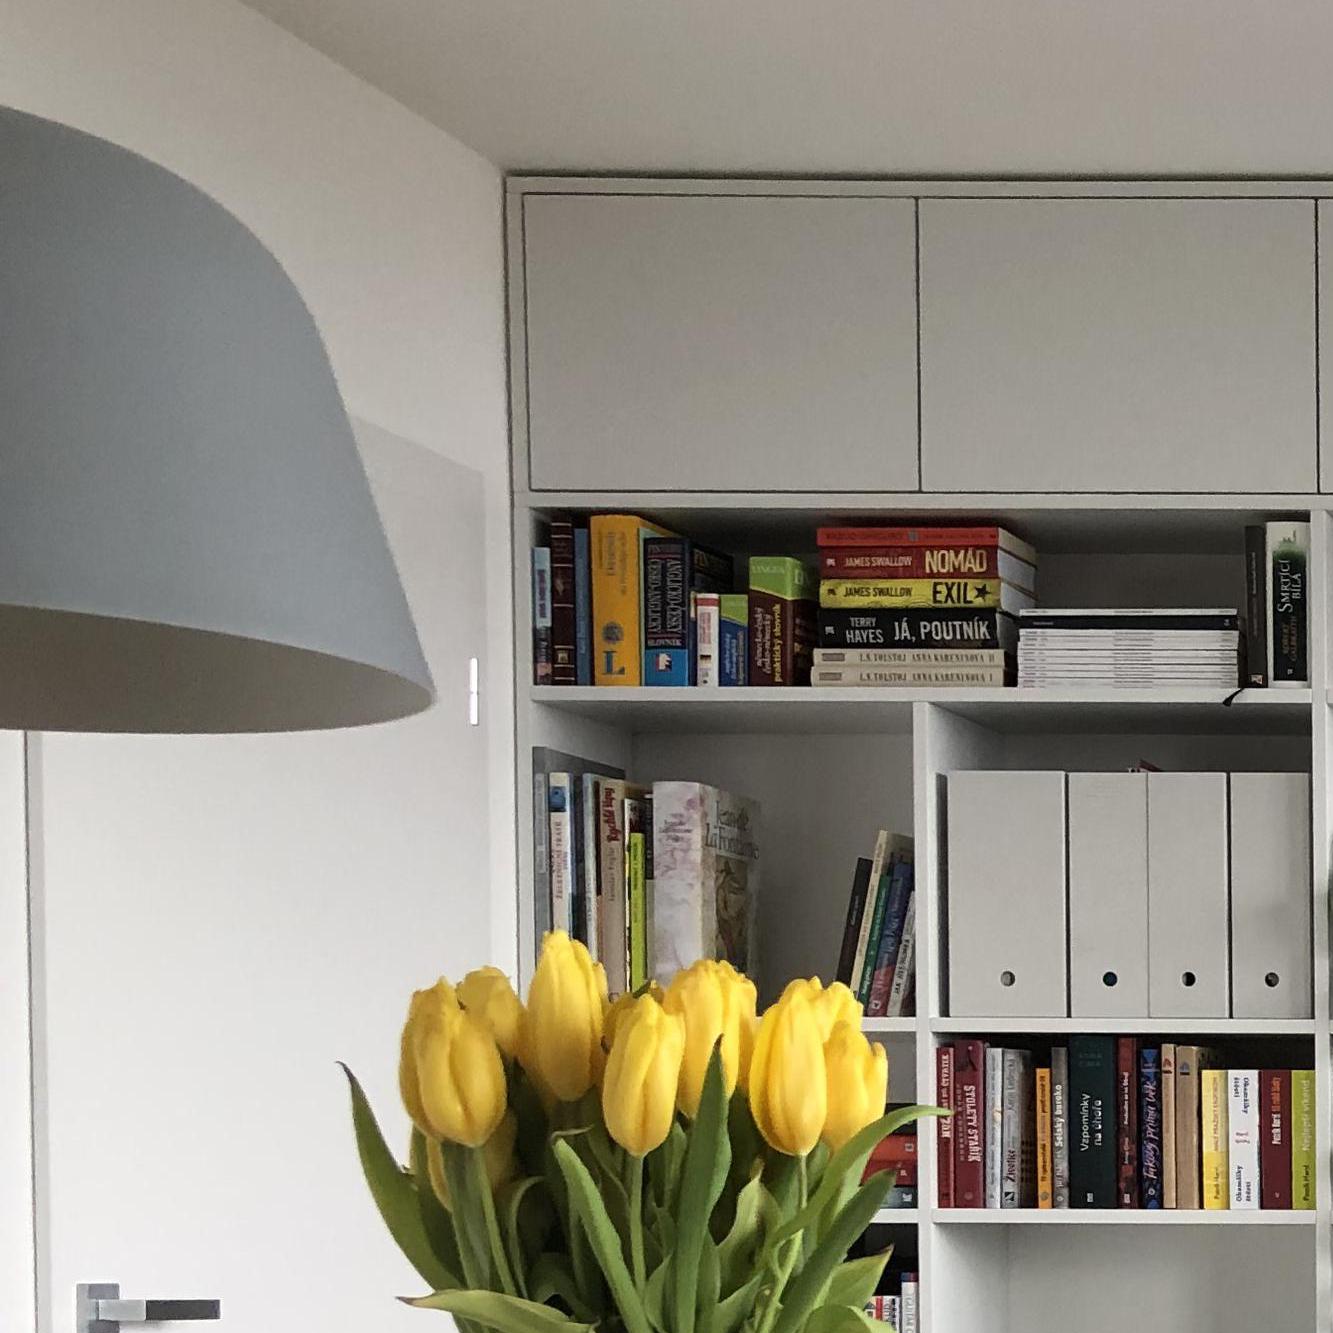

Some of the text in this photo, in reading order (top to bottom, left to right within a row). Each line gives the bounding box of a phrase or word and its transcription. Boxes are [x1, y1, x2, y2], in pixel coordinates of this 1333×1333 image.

[844, 556, 913, 567] JAMES SWALLOW
[925, 548, 987, 574] NOMÁD
[843, 587, 913, 598] JAMES SWALLOW
[932, 582, 974, 605] EXIL
[1276, 560, 1293, 613] SMRTÍCÍ
[1290, 572, 1302, 600] BÍLÁ
[849, 617, 877, 628] TERRY
[894, 619, 991, 643] JÁ, POUTNÍK
[773, 603, 783, 682] praktický slovník
[845, 630, 884, 645] HAYES
[1300, 1079, 1311, 1112] víkend
[1053, 1084, 1065, 1147] Selský baroko
[1080, 1093, 1092, 1151] Vzpomínky
[1093, 1132, 1102, 1146] na
[1005, 1149, 1017, 1182] Životice
[1142, 1141, 1158, 1179] Takový
[905, 1296, 915, 1326] GUITAR
